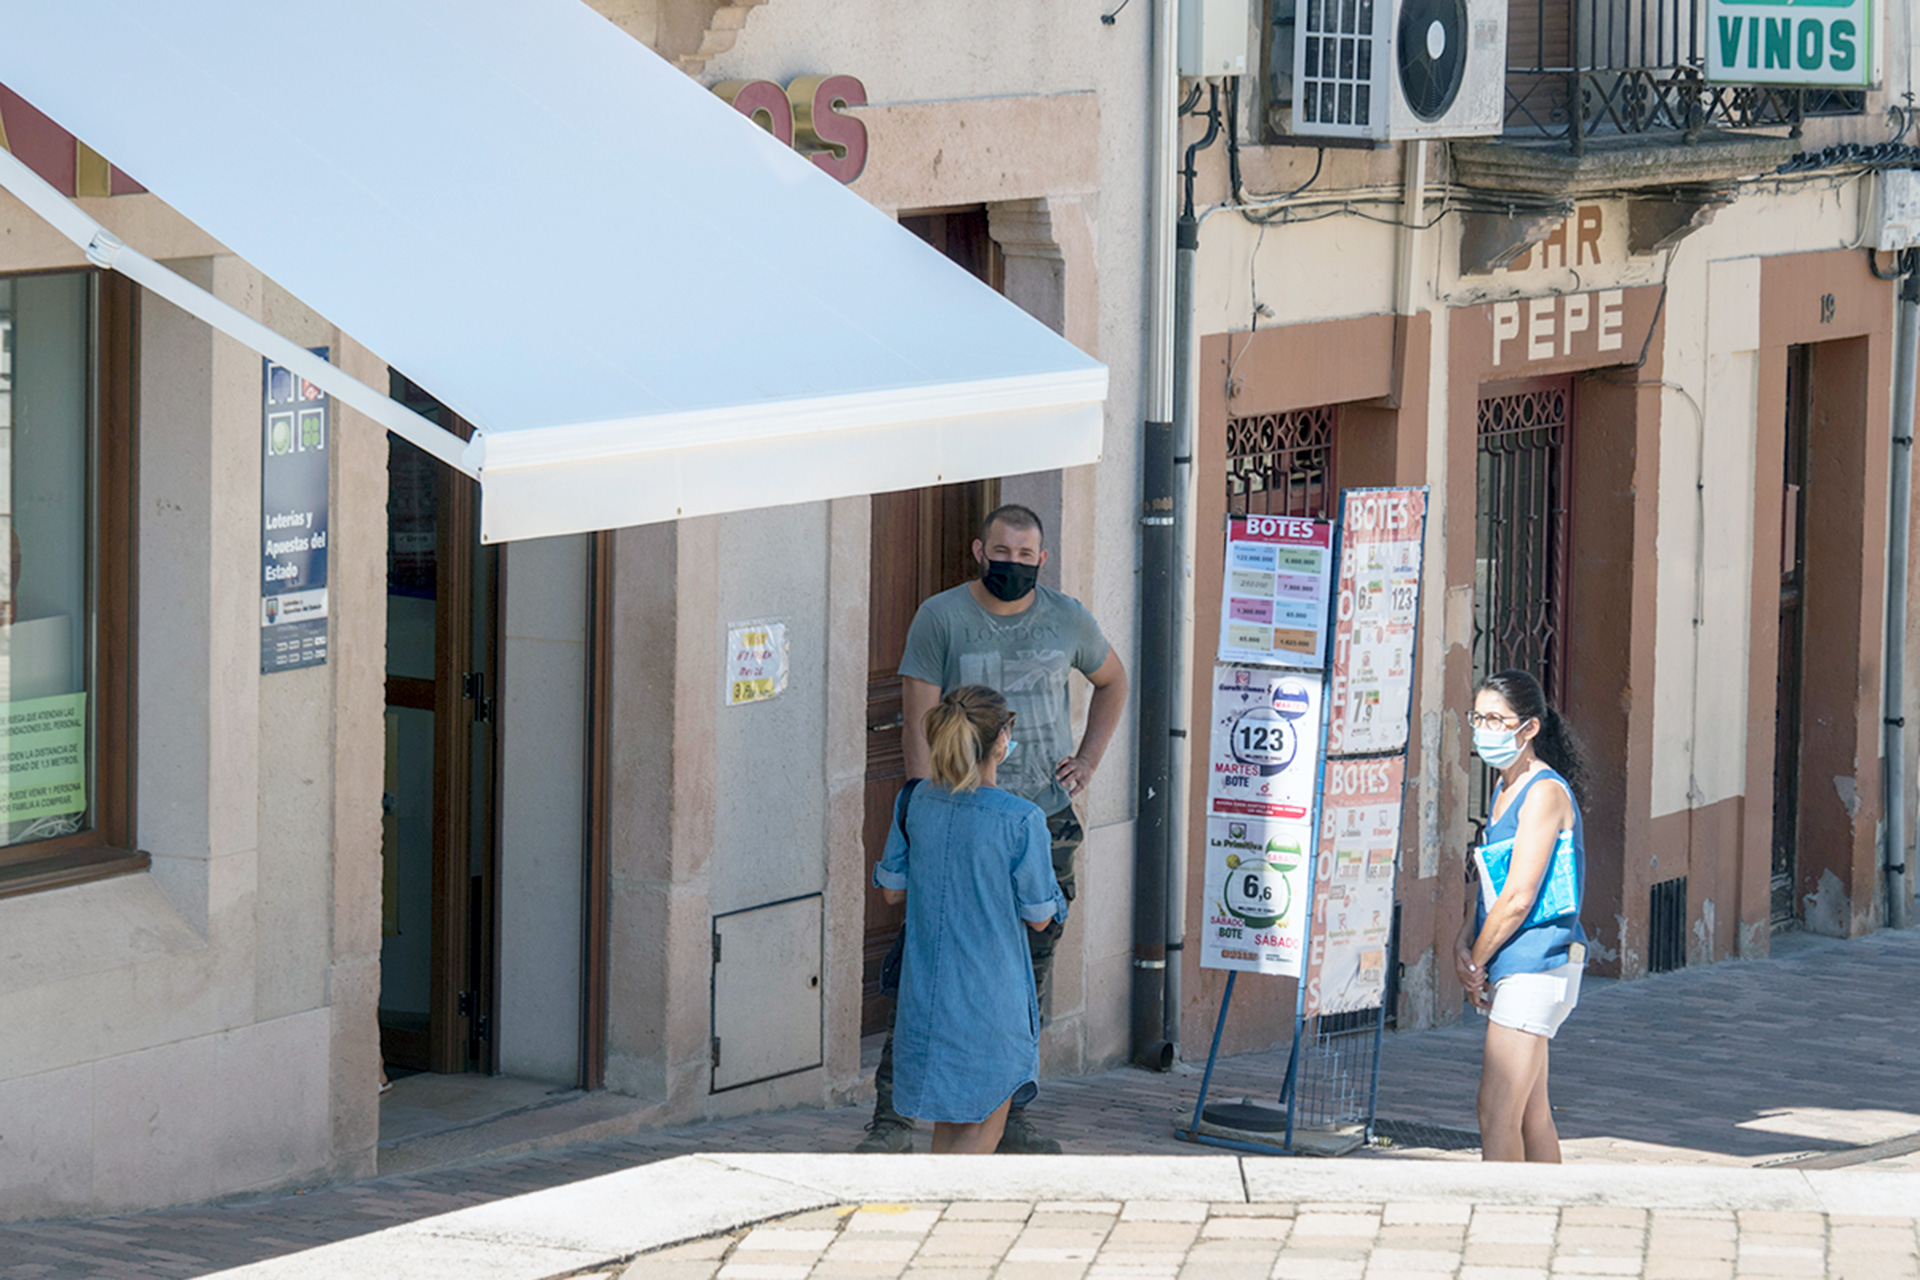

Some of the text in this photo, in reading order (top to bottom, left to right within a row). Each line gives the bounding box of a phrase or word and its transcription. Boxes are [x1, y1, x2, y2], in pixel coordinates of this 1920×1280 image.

[1718, 16, 1856, 71] VINOS
[1820, 293, 1836, 324] 19
[1493, 289, 1623, 366] PEPE
[265, 510, 314, 530] Loterías y
[1350, 497, 1409, 532] BOTES
[1246, 518, 1315, 539] BOTES
[264, 531, 326, 559] Apuestas del
[265, 561, 299, 582] Estado
[1392, 587, 1413, 611] 123
[964, 624, 1061, 643] LONDON
[1241, 726, 1284, 751] 123
[1215, 762, 1259, 777] MARTES
[1330, 762, 1391, 796] BOTES
[1224, 774, 1250, 788] BOTE
[1211, 838, 1263, 851] La Primitiva
[1243, 874, 1273, 902] 6,6
[1219, 927, 1243, 940] BOTE
[1254, 932, 1300, 950] SÁBADO
